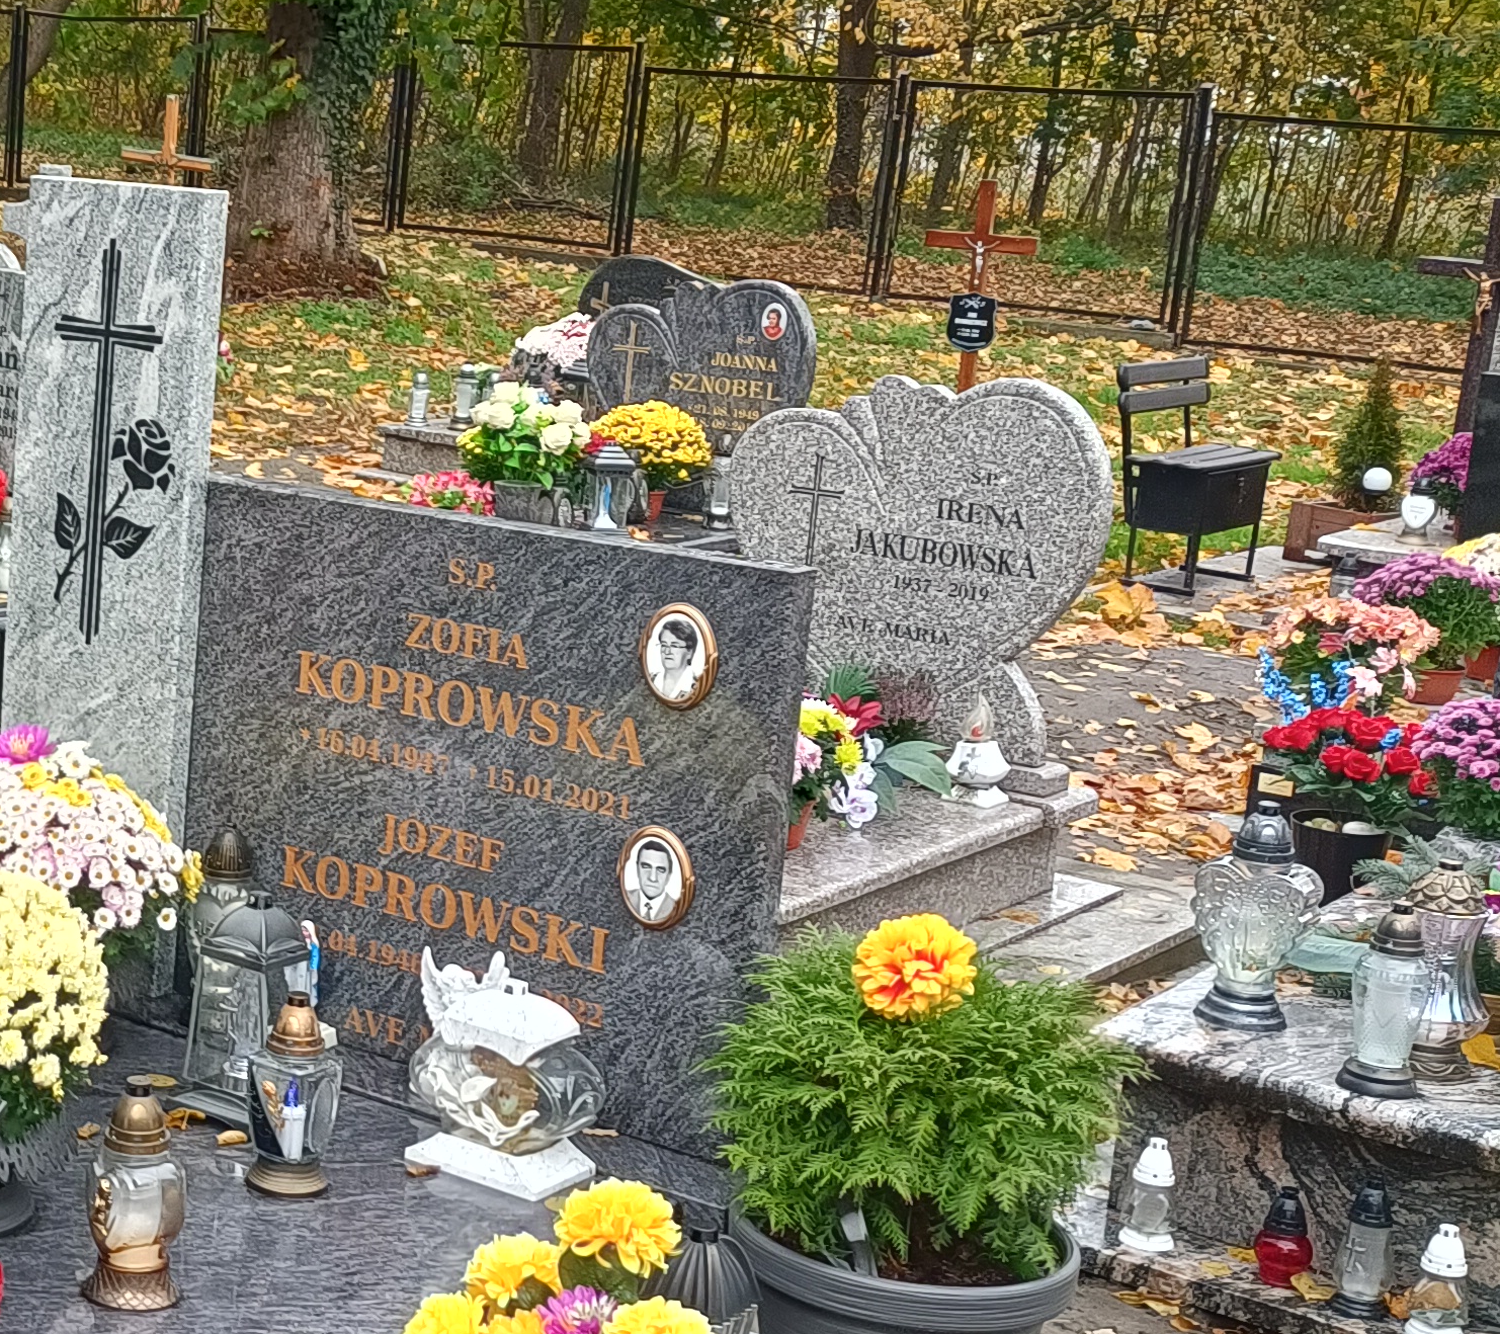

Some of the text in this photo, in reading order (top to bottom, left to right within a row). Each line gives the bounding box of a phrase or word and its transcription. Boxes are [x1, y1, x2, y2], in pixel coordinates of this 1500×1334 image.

[710, 352, 778, 373] JOANNA
[669, 372, 785, 402] SZNOBEL
[936, 498, 1025, 531] IRENA
[850, 528, 1037, 580] JAKUBOWSKA
[892, 574, 932, 594] 1937
[947, 582, 990, 602] 2019
[404, 612, 529, 670] ZOFIA
[885, 622, 951, 646] MARIA
[295, 649, 646, 767] KOPROWSKA
[281, 844, 611, 974] KOPROWSKI
[344, 1004, 406, 1046] AVE
